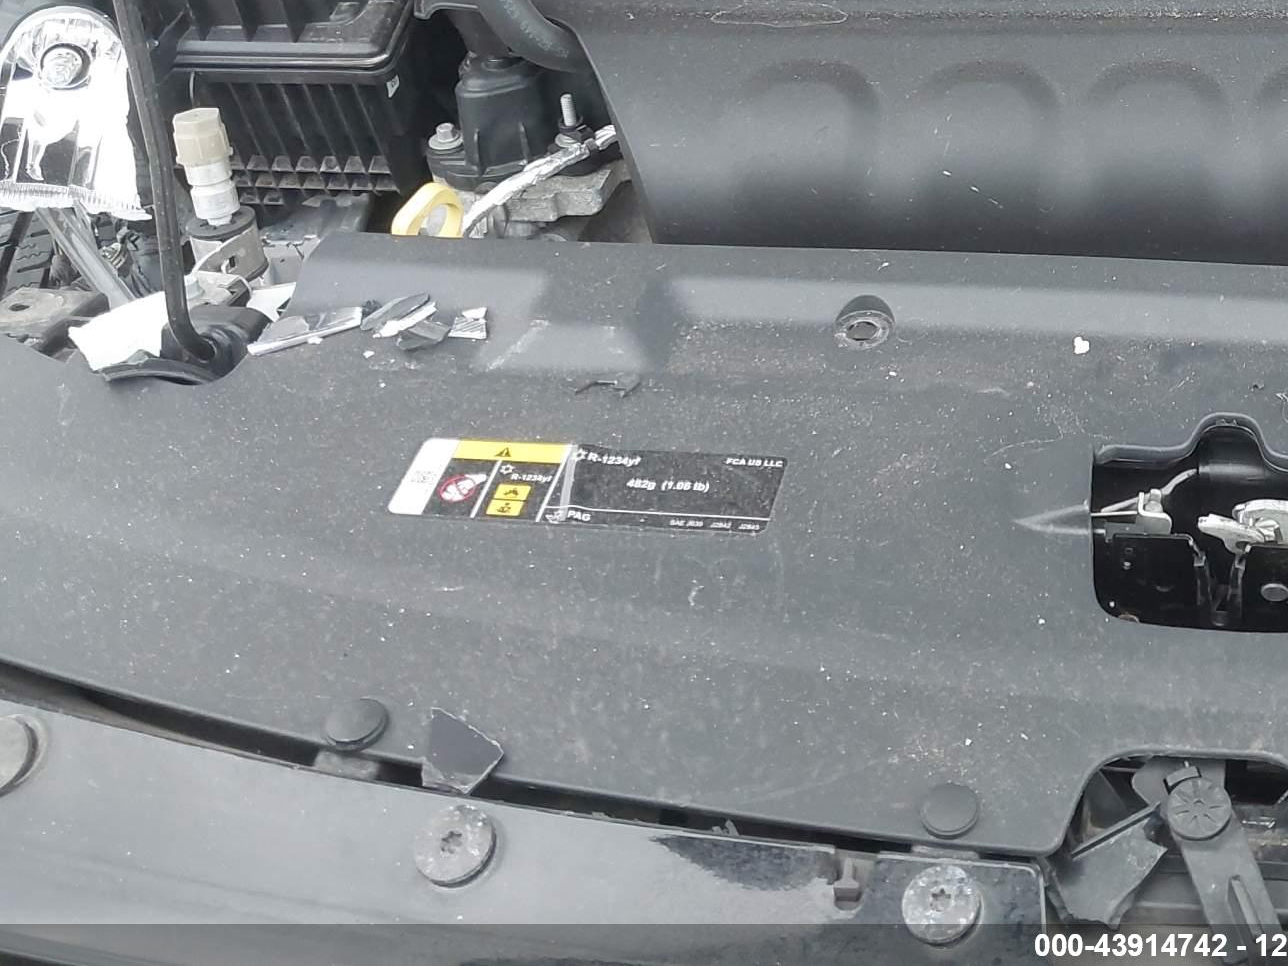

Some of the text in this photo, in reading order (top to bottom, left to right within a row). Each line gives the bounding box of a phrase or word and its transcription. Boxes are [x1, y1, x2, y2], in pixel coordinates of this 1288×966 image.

[587, 452, 642, 468] R-1234yf
[725, 457, 746, 466] FCA
[763, 459, 784, 468] LLC
[626, 478, 655, 492] 482g
[567, 510, 591, 522] PAG
